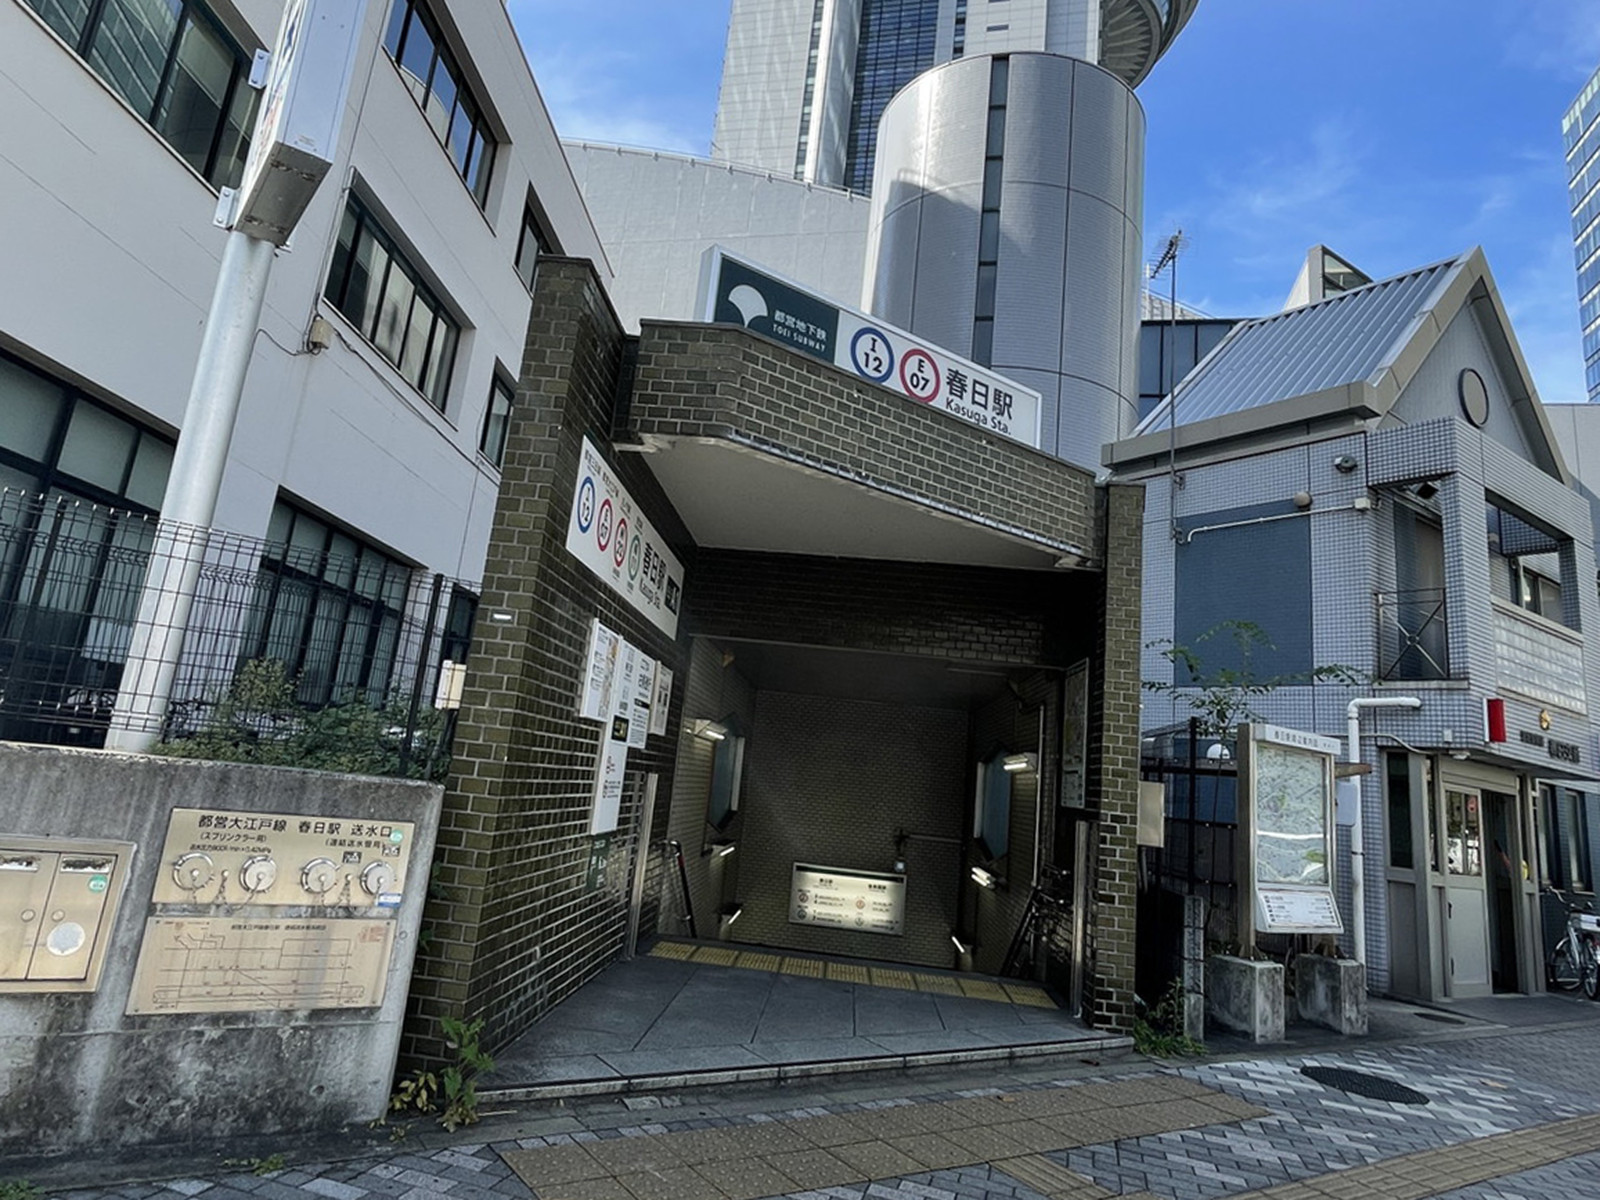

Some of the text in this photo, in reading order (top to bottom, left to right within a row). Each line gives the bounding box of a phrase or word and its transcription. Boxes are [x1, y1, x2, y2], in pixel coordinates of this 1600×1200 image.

[772, 323, 826, 352] TOEI SUBWAY
[774, 309, 827, 342] 都営地下鉄
[870, 337, 877, 353] I
[863, 352, 883, 374] 12
[917, 358, 925, 374] E
[910, 372, 930, 392] 07
[946, 367, 1013, 420] 春日駅
[945, 396, 1012, 436] Kasuga Sta.
[581, 501, 590, 523] 12
[643, 542, 667, 591] 春日駅
[198, 814, 392, 838] 都営大江戸線 春日駅 送水口
